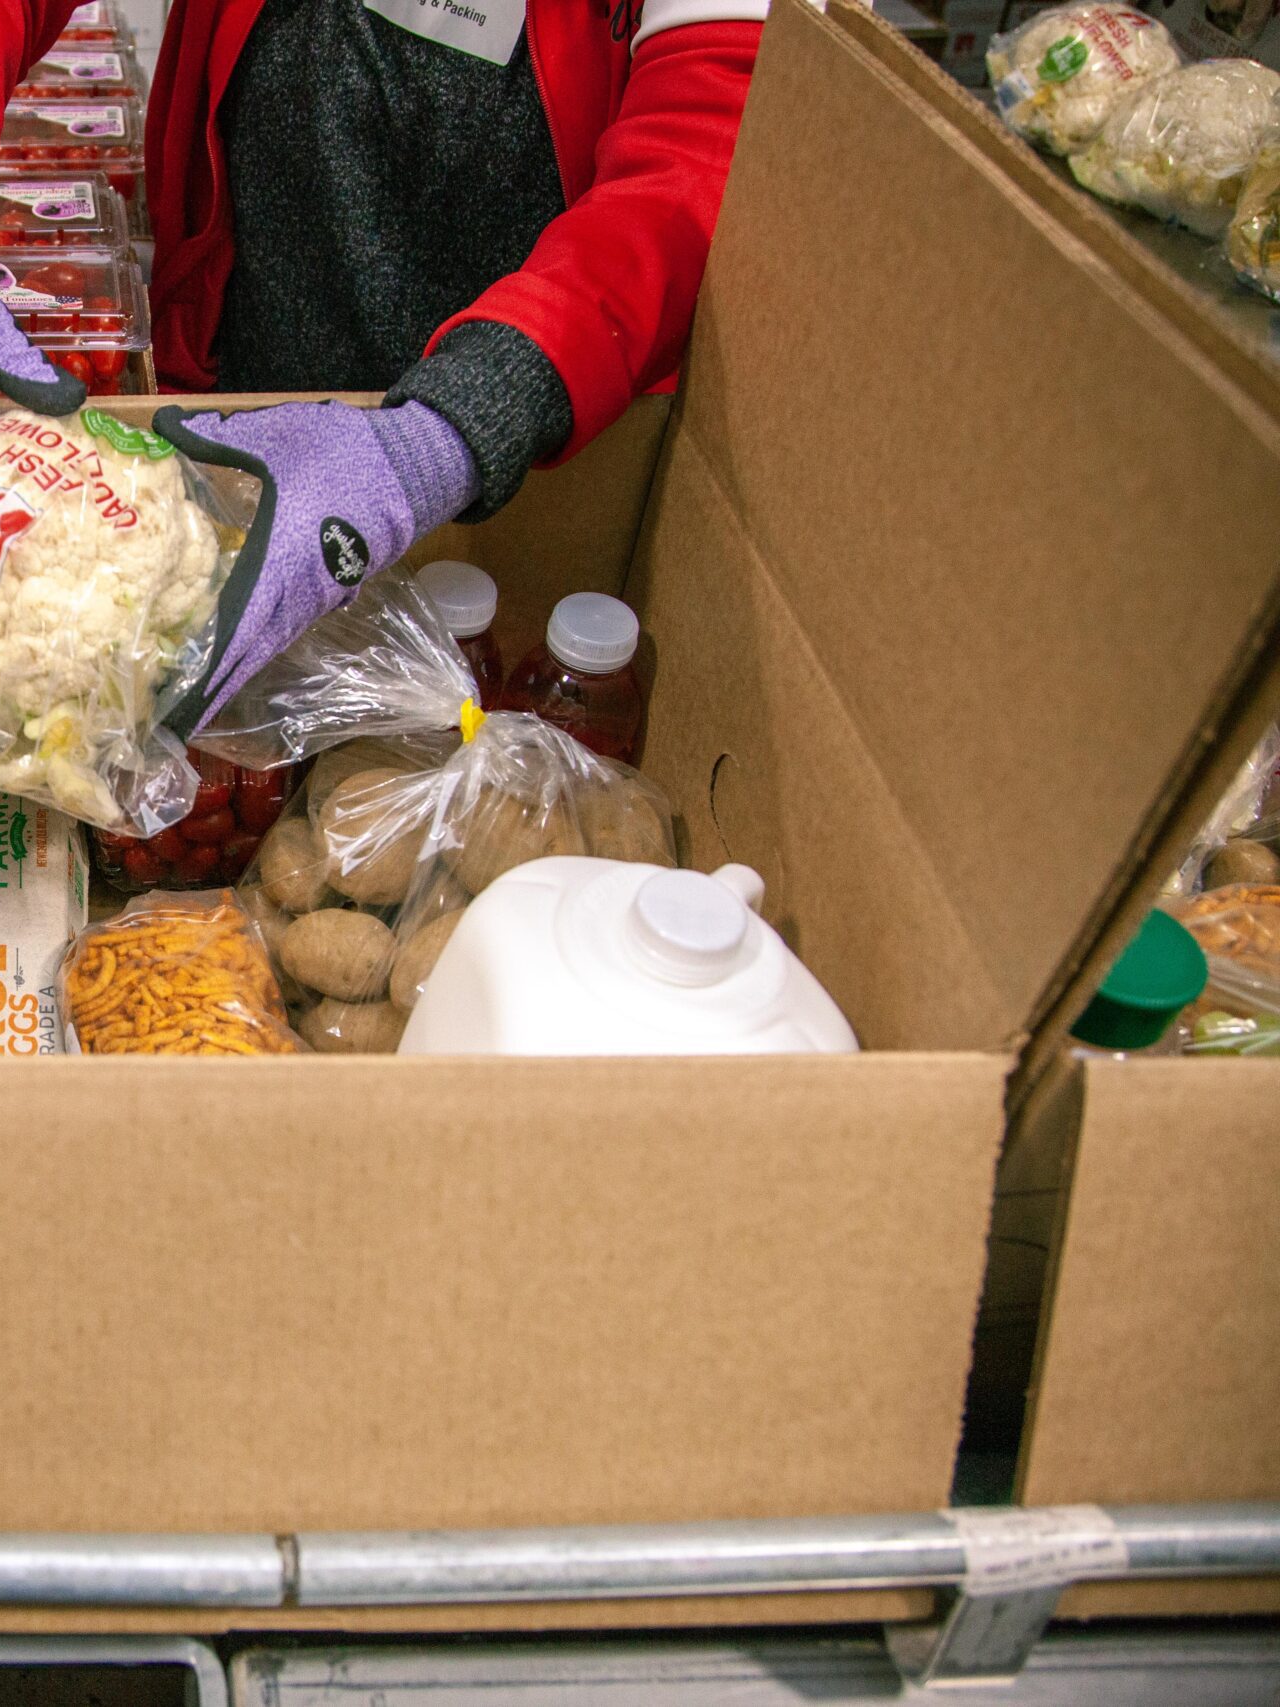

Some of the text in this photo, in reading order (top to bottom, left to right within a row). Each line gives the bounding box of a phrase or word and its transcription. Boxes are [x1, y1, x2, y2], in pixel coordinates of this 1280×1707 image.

[442, 0, 487, 26] Packing
[7, 993, 39, 1056] GGS
[38, 985, 55, 1056] RADE A
